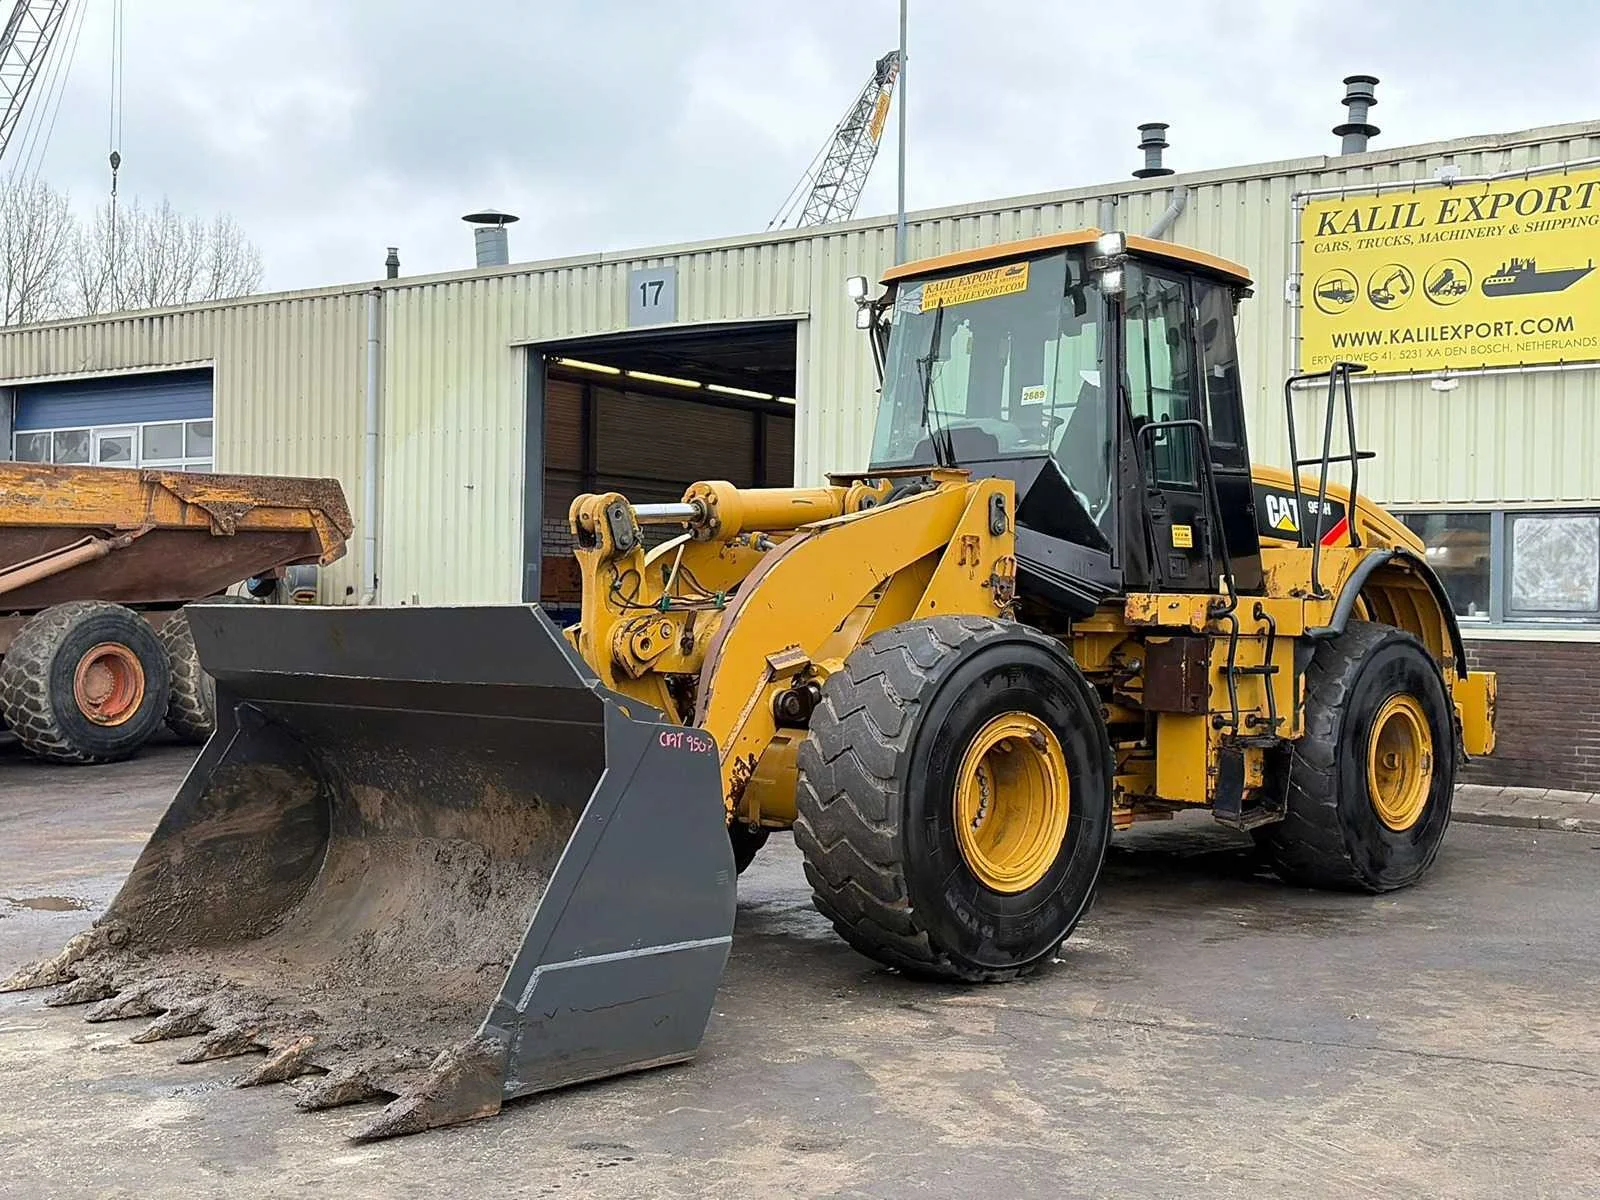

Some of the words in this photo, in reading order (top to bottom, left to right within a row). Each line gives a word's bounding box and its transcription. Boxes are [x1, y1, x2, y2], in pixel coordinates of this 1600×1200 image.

[1314, 202, 1425, 237] KALIL
[1434, 181, 1600, 225] EXPORT
[1314, 240, 1352, 254] CARS,
[1356, 234, 1414, 250] TRUCKS,
[1418, 225, 1506, 244] MACHINERY
[1508, 223, 1520, 235] &
[1524, 215, 1600, 233] SHIPPING
[640, 280, 664, 307] 17
[926, 282, 956, 294] KALIL
[959, 269, 1002, 287] EXPORT
[1331, 316, 1574, 348] WWW.KALILEXPORT.COM
[1399, 349, 1422, 360] 5231
[1426, 348, 1441, 358] XA
[1444, 346, 1467, 356] DEN
[1516, 336, 1598, 352] NETHERLANDS
[1265, 494, 1300, 532] CAT
[659, 731, 684, 749] CAT
